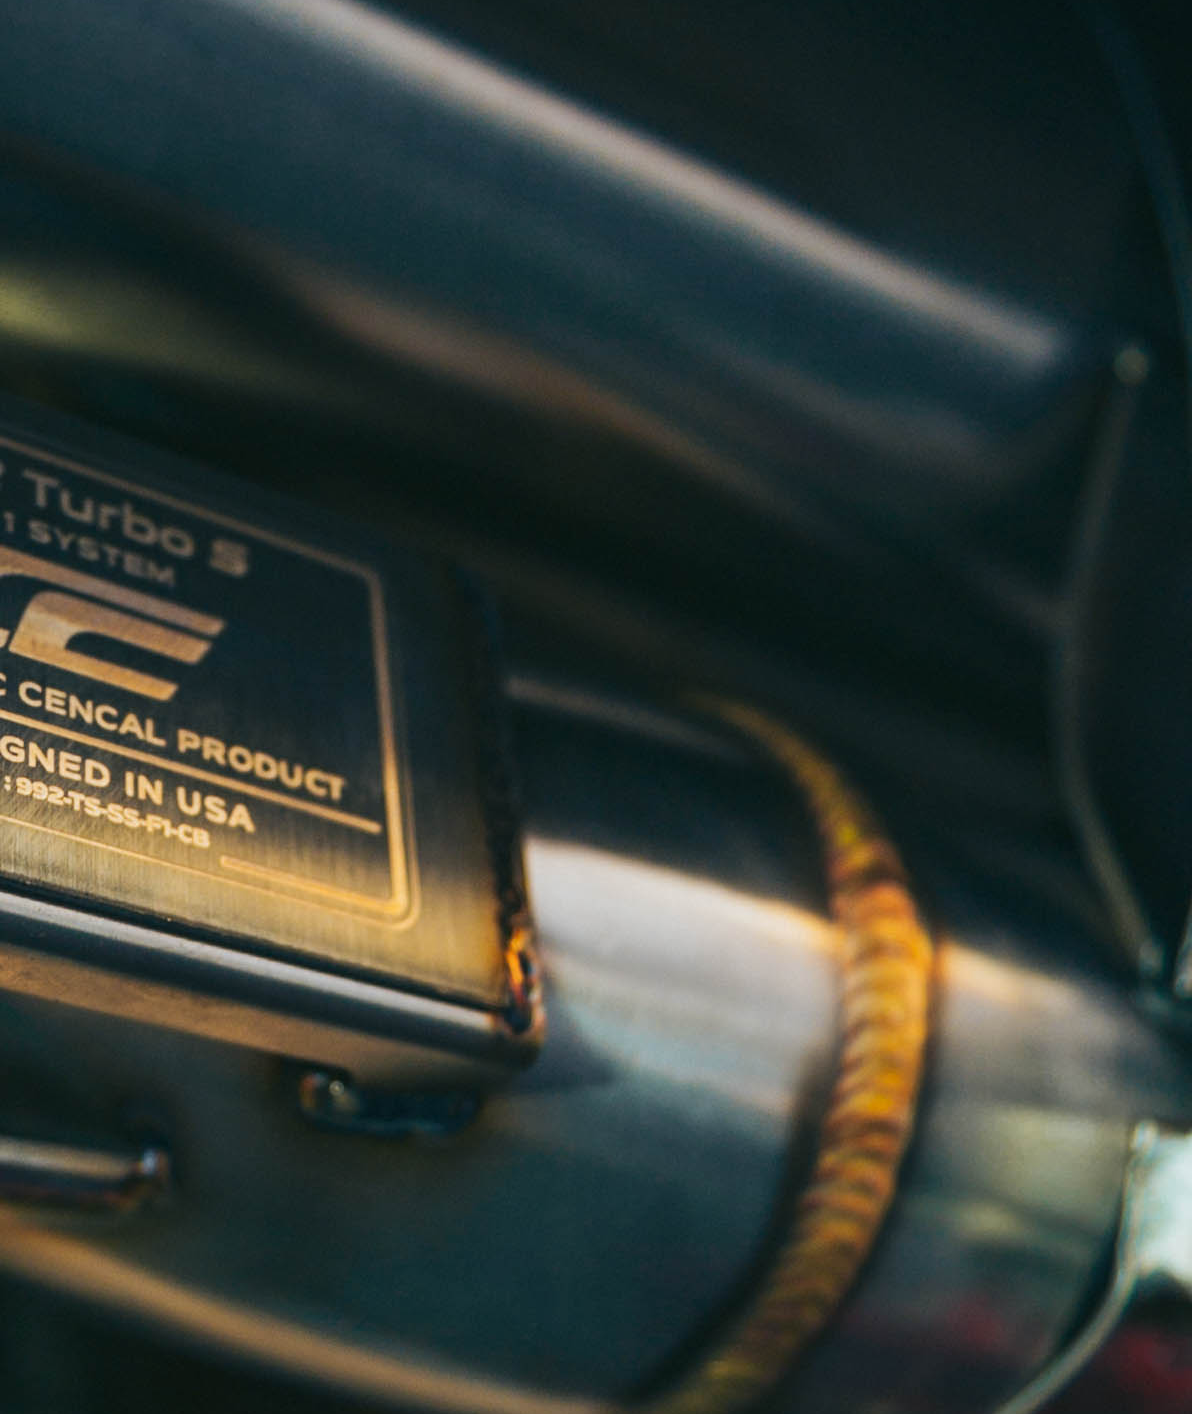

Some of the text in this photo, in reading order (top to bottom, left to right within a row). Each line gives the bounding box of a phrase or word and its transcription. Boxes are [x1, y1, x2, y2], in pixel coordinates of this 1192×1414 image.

[22, 466, 195, 558] Turbo
[208, 537, 249, 578] S
[27, 520, 176, 585] SYSTEM
[18, 681, 167, 747] CENCAL
[177, 729, 346, 801] PRODUCT
[124, 771, 163, 806] IN
[176, 787, 256, 834] USA
